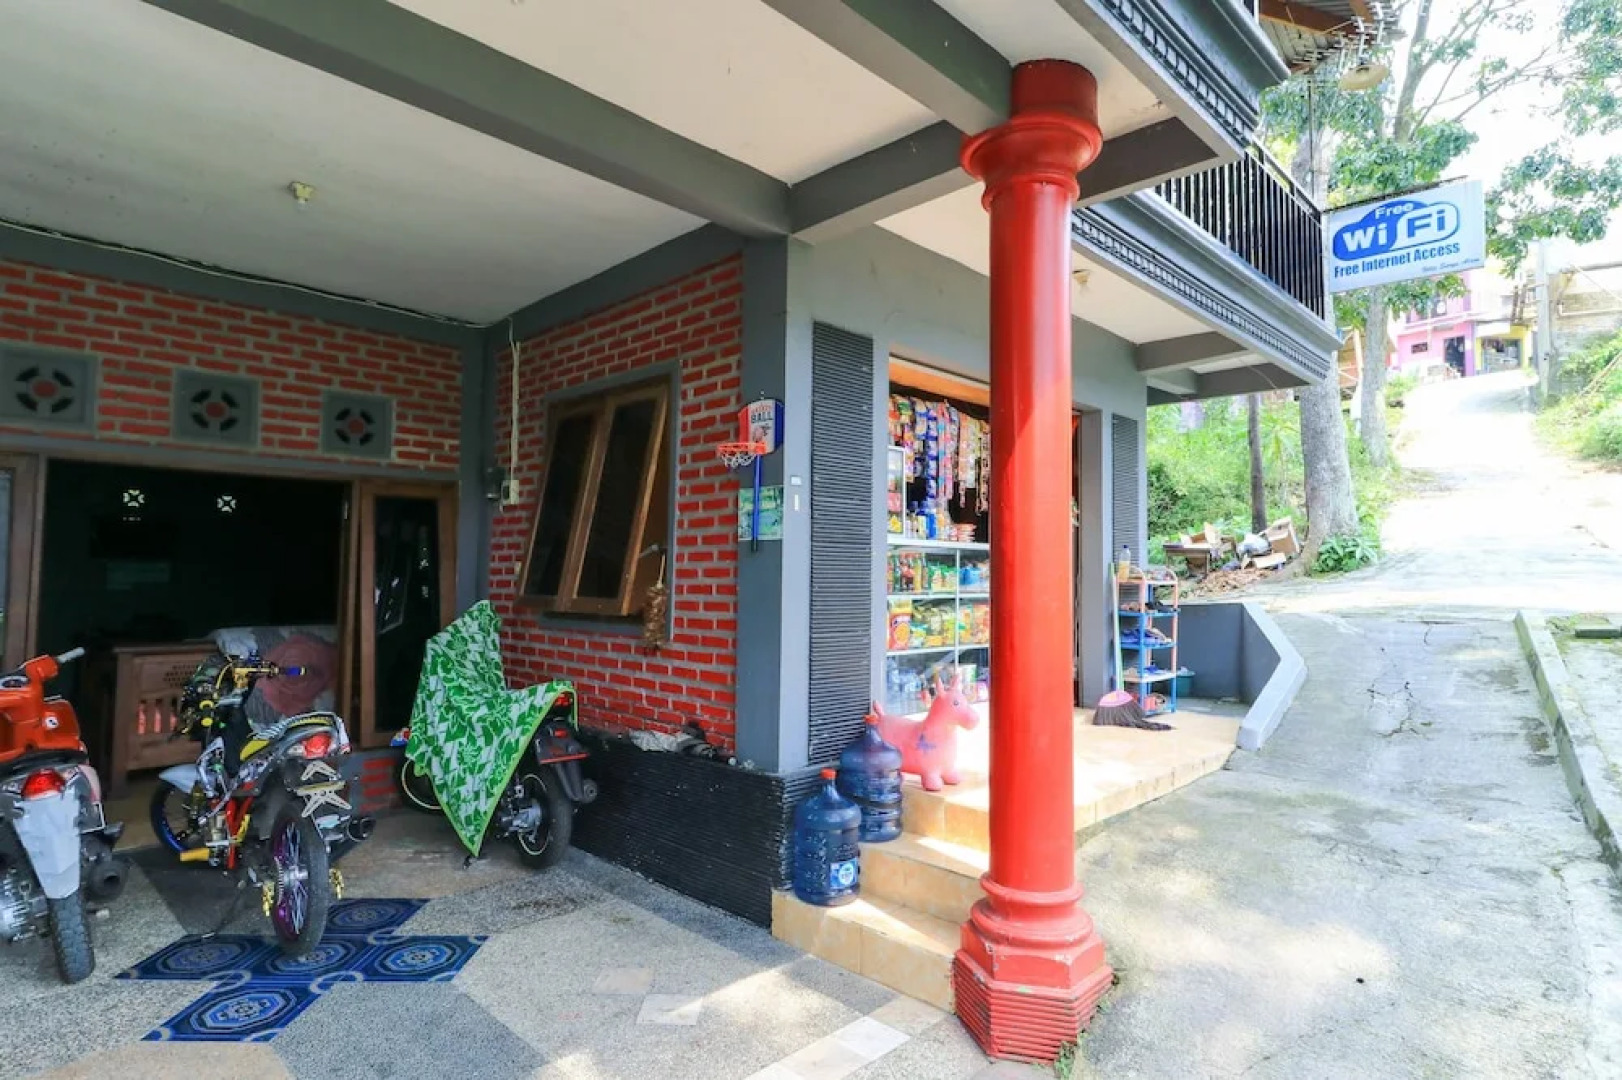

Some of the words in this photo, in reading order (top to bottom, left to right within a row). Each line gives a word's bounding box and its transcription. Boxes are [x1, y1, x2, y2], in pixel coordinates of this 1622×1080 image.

[1375, 203, 1414, 219] Free
[1335, 264, 1359, 278] Free
[1362, 252, 1410, 273] Internet
[1414, 243, 1460, 262] Access
